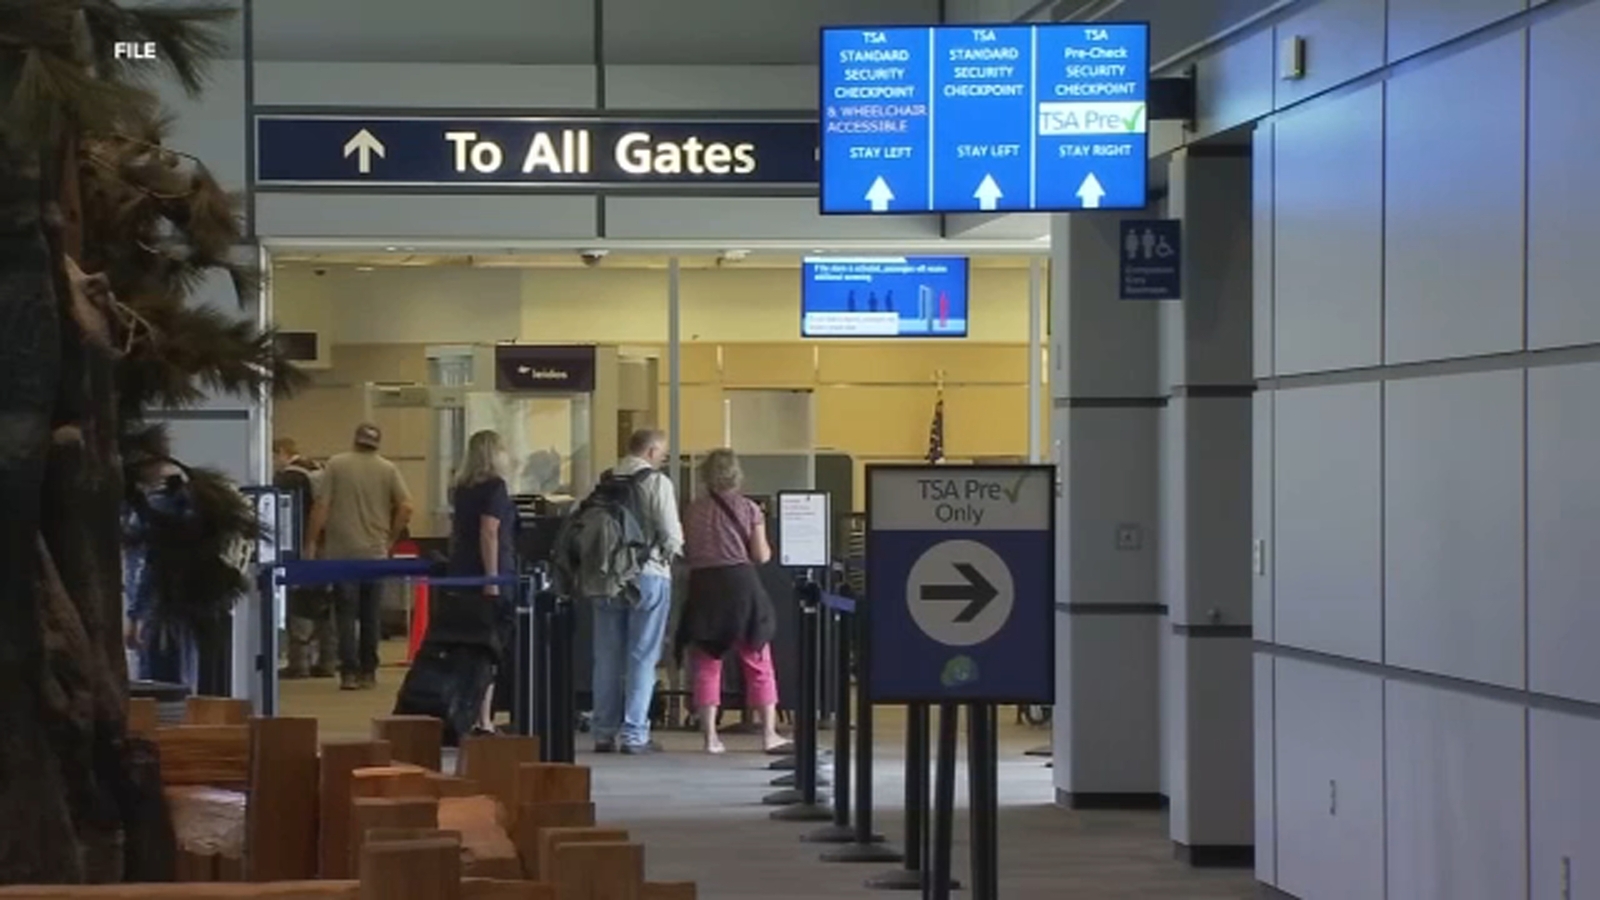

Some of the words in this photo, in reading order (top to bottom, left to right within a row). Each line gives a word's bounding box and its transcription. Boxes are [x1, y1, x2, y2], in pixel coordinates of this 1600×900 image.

[862, 31, 887, 43] TSA
[972, 30, 996, 42] TSA
[1084, 29, 1109, 40] TSA
[839, 50, 910, 63] STANDARD
[949, 48, 1019, 61] STANDARD
[1064, 47, 1128, 58] Pre-Check
[844, 67, 905, 80] SECURITY
[954, 66, 1014, 78] SECURITY
[1066, 65, 1126, 77] SECURITY
[834, 86, 915, 98] CHECKPOINT
[943, 84, 1024, 97] CHECKPOINT
[1054, 82, 1136, 96] CHECKPOINT
[840, 105, 928, 117] WHEELCHAIR
[826, 120, 909, 133] ACCESSIBLE
[1040, 111, 1079, 130] TSA
[1084, 110, 1120, 130] Pre
[445, 132, 503, 174] To
[522, 130, 589, 174] All
[615, 132, 756, 174] Gates
[849, 146, 881, 159] STAY
[884, 146, 913, 158] LEFT
[956, 145, 988, 158] STAY
[991, 144, 1020, 157] LEFT
[1058, 144, 1089, 157] STAY
[1092, 144, 1132, 156] RIGHT
[917, 479, 960, 500] TSA
[965, 479, 1001, 500] Pre
[934, 504, 984, 526] Only
